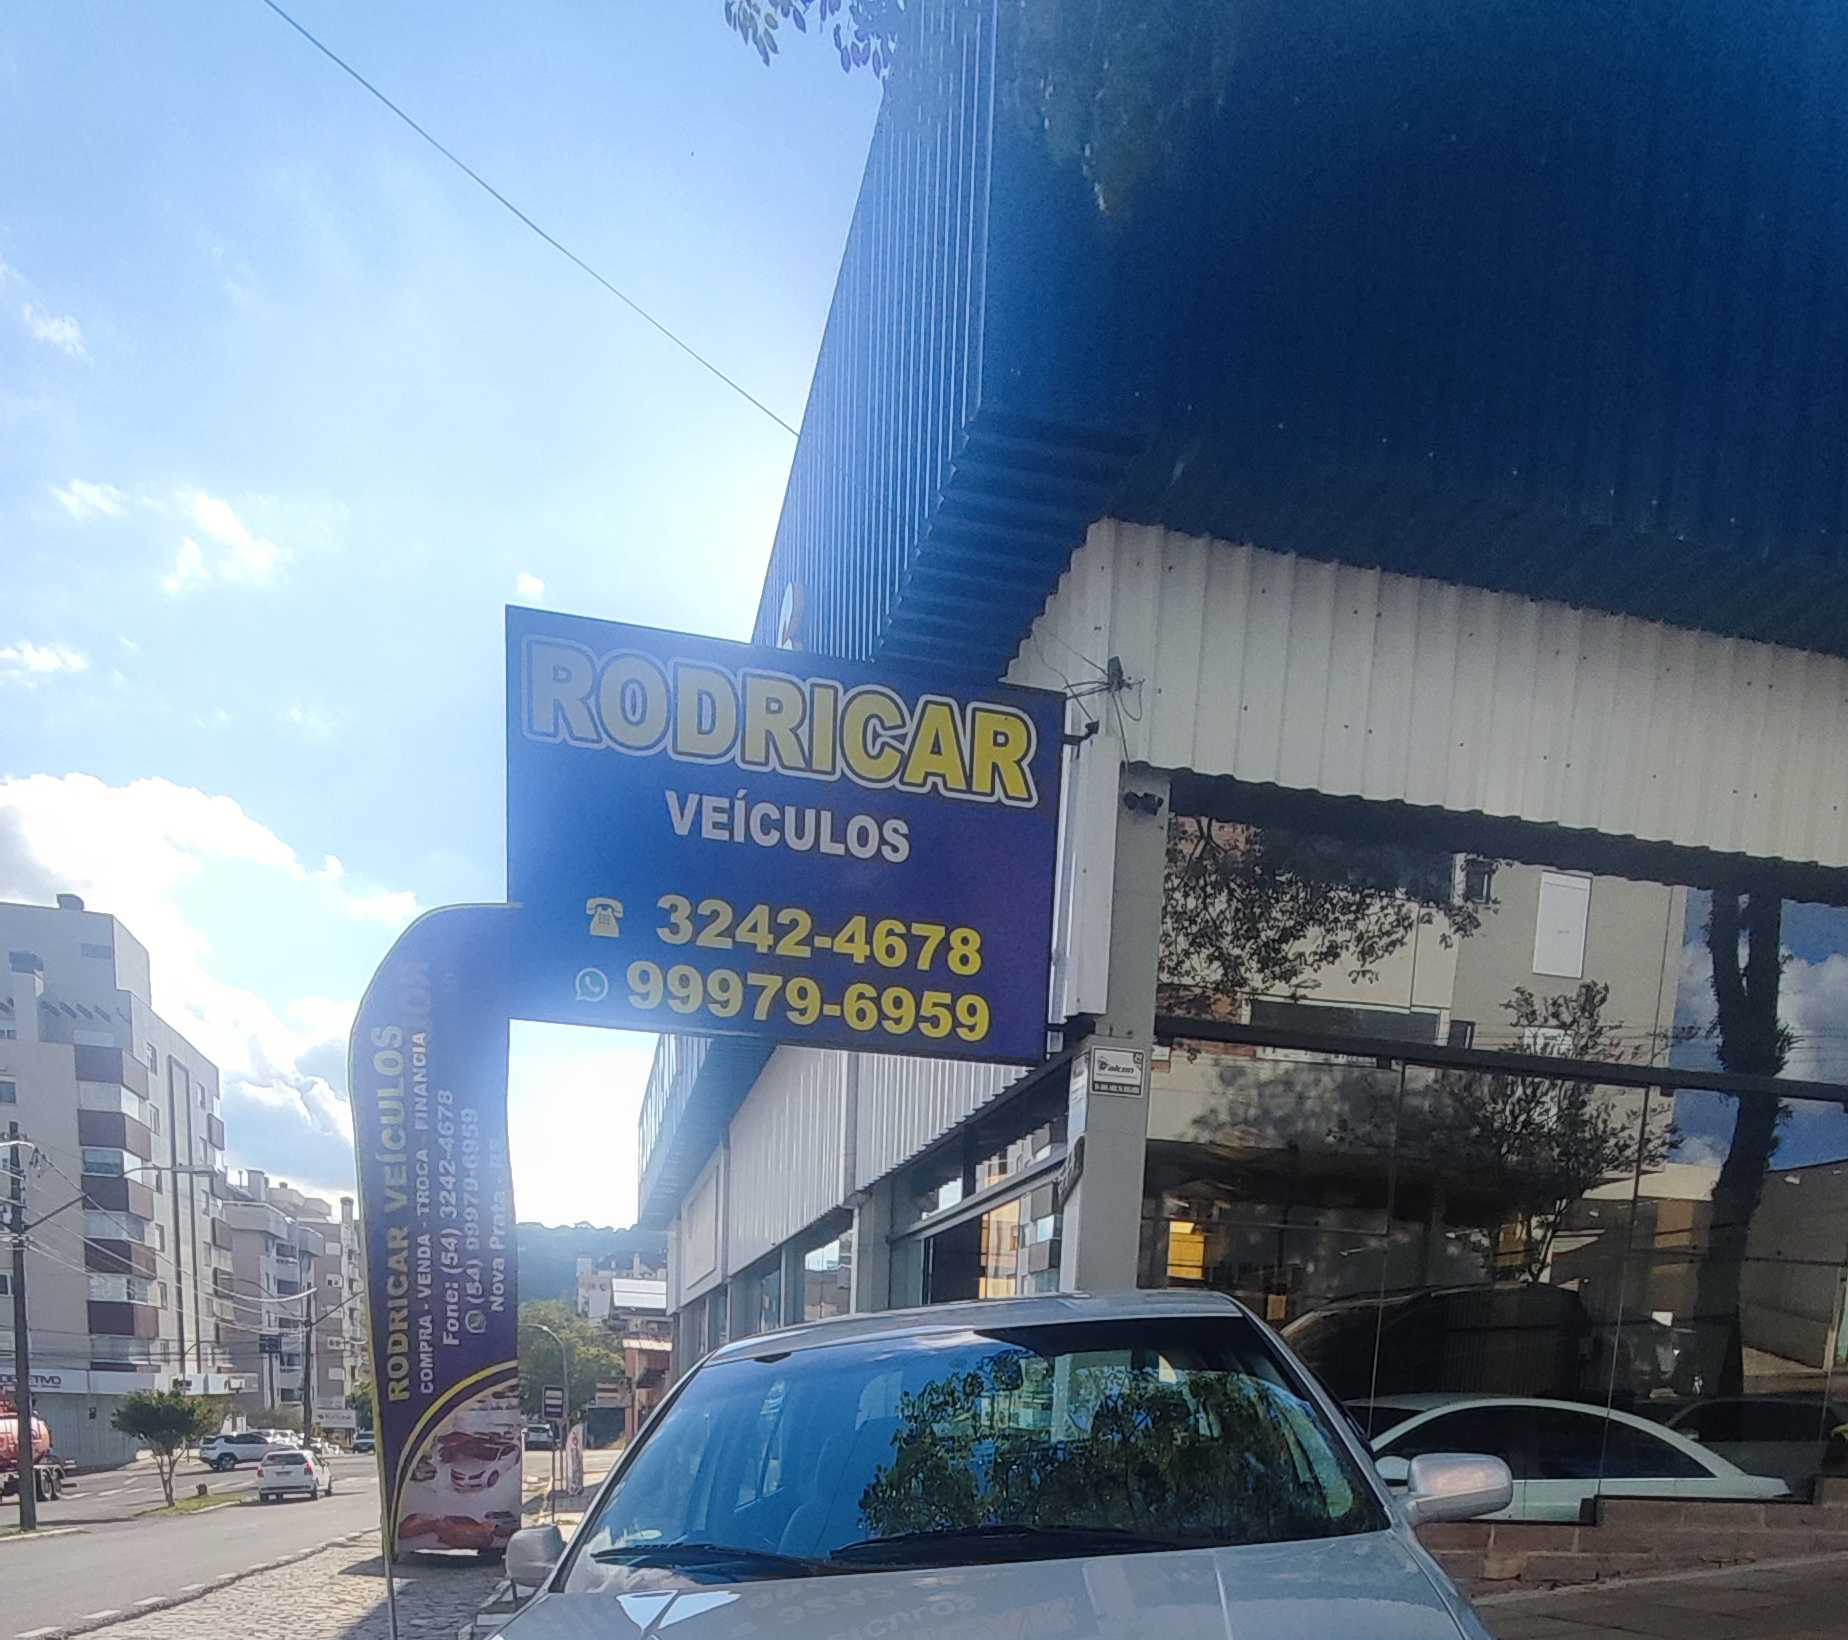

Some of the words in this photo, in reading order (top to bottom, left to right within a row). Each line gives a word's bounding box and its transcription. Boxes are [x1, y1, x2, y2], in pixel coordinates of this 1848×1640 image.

[522, 635, 1037, 807] RODRICAR
[666, 790, 910, 863] VEÍCULOS
[656, 895, 983, 976] 3242-4678
[626, 961, 990, 1042] 99979-6959
[411, 1031, 430, 1130] FINANCIA
[415, 1148, 430, 1215] TROCA
[438, 1089, 458, 1218] 3242-4678
[461, 1107, 480, 1250] 99979-6959
[417, 1233, 432, 1297] VENDA
[439, 1226, 463, 1274] (54)
[464, 1257, 484, 1303] (54)
[490, 1257, 505, 1311] Nova
[387, 1224, 409, 1400] RODRICAR
[443, 1281, 459, 1344] Fone:
[418, 1314, 433, 1393] COMPRA
